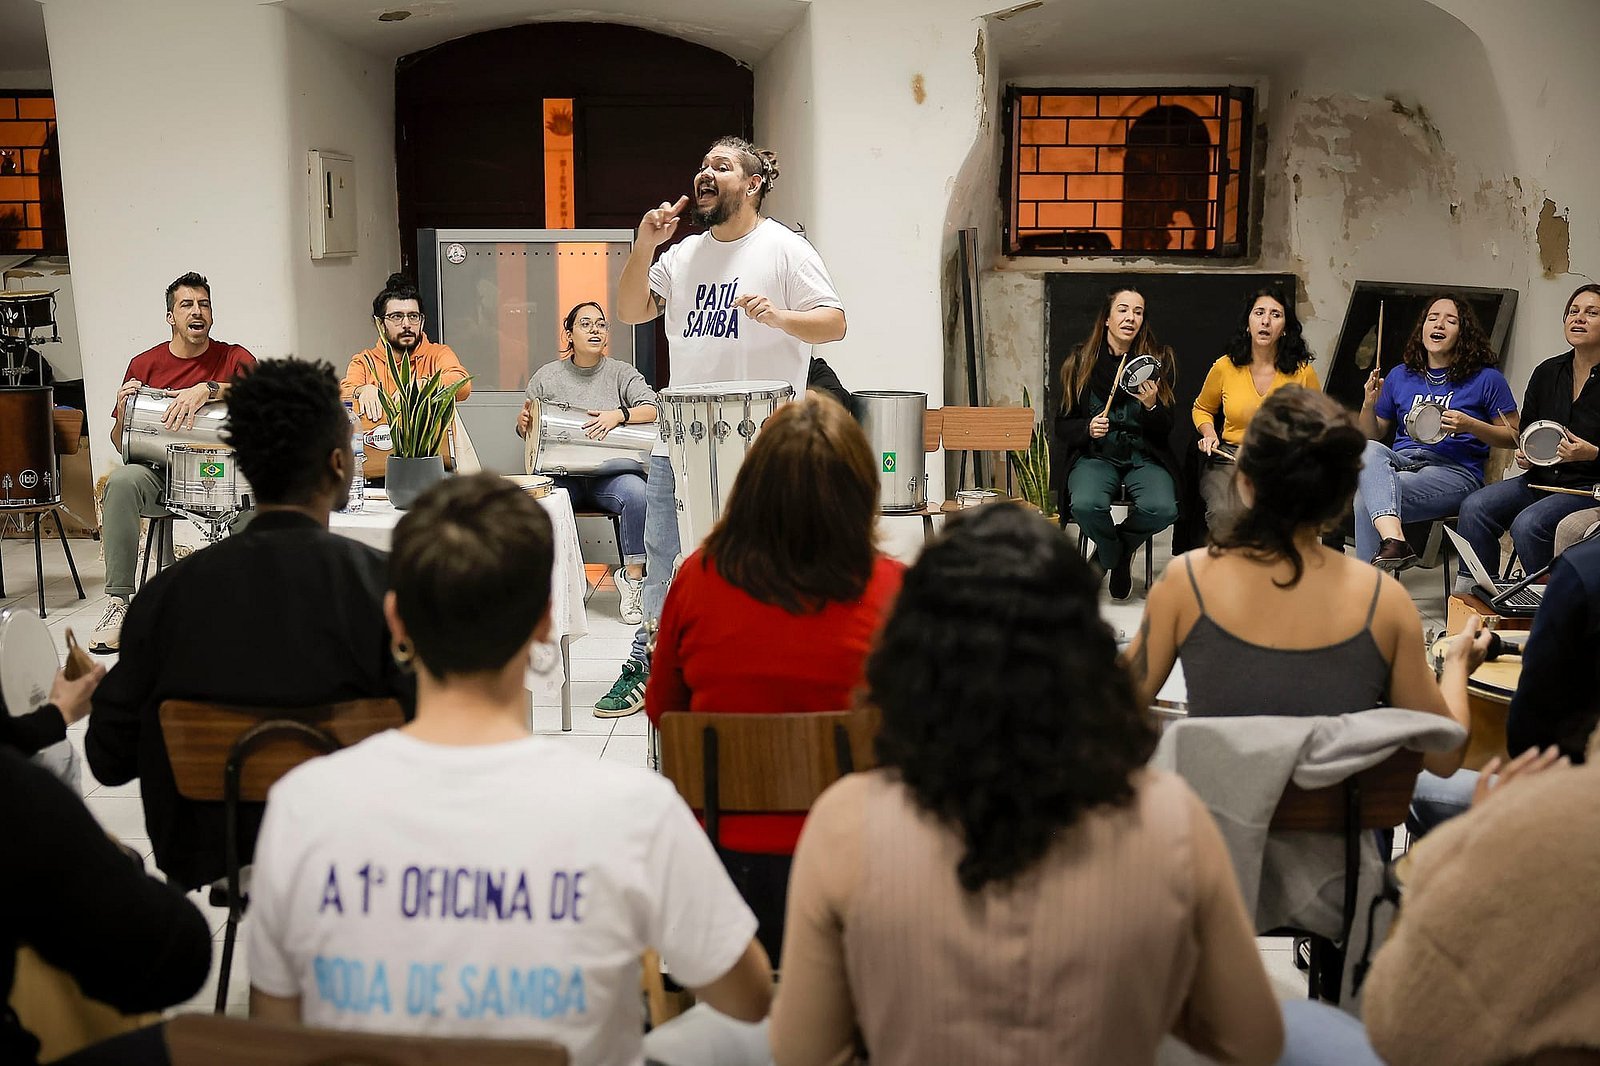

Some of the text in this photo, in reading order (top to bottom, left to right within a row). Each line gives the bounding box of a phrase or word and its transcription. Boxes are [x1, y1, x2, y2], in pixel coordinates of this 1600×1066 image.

[559, 158, 568, 229] BIENVENI
[696, 276, 739, 311] PATÚ
[683, 309, 739, 339] SAMBA
[319, 863, 344, 915] A
[401, 866, 532, 921] OFICINA
[550, 871, 586, 922] DE
[405, 963, 446, 1017] DE
[456, 963, 587, 1019] SAMBA
